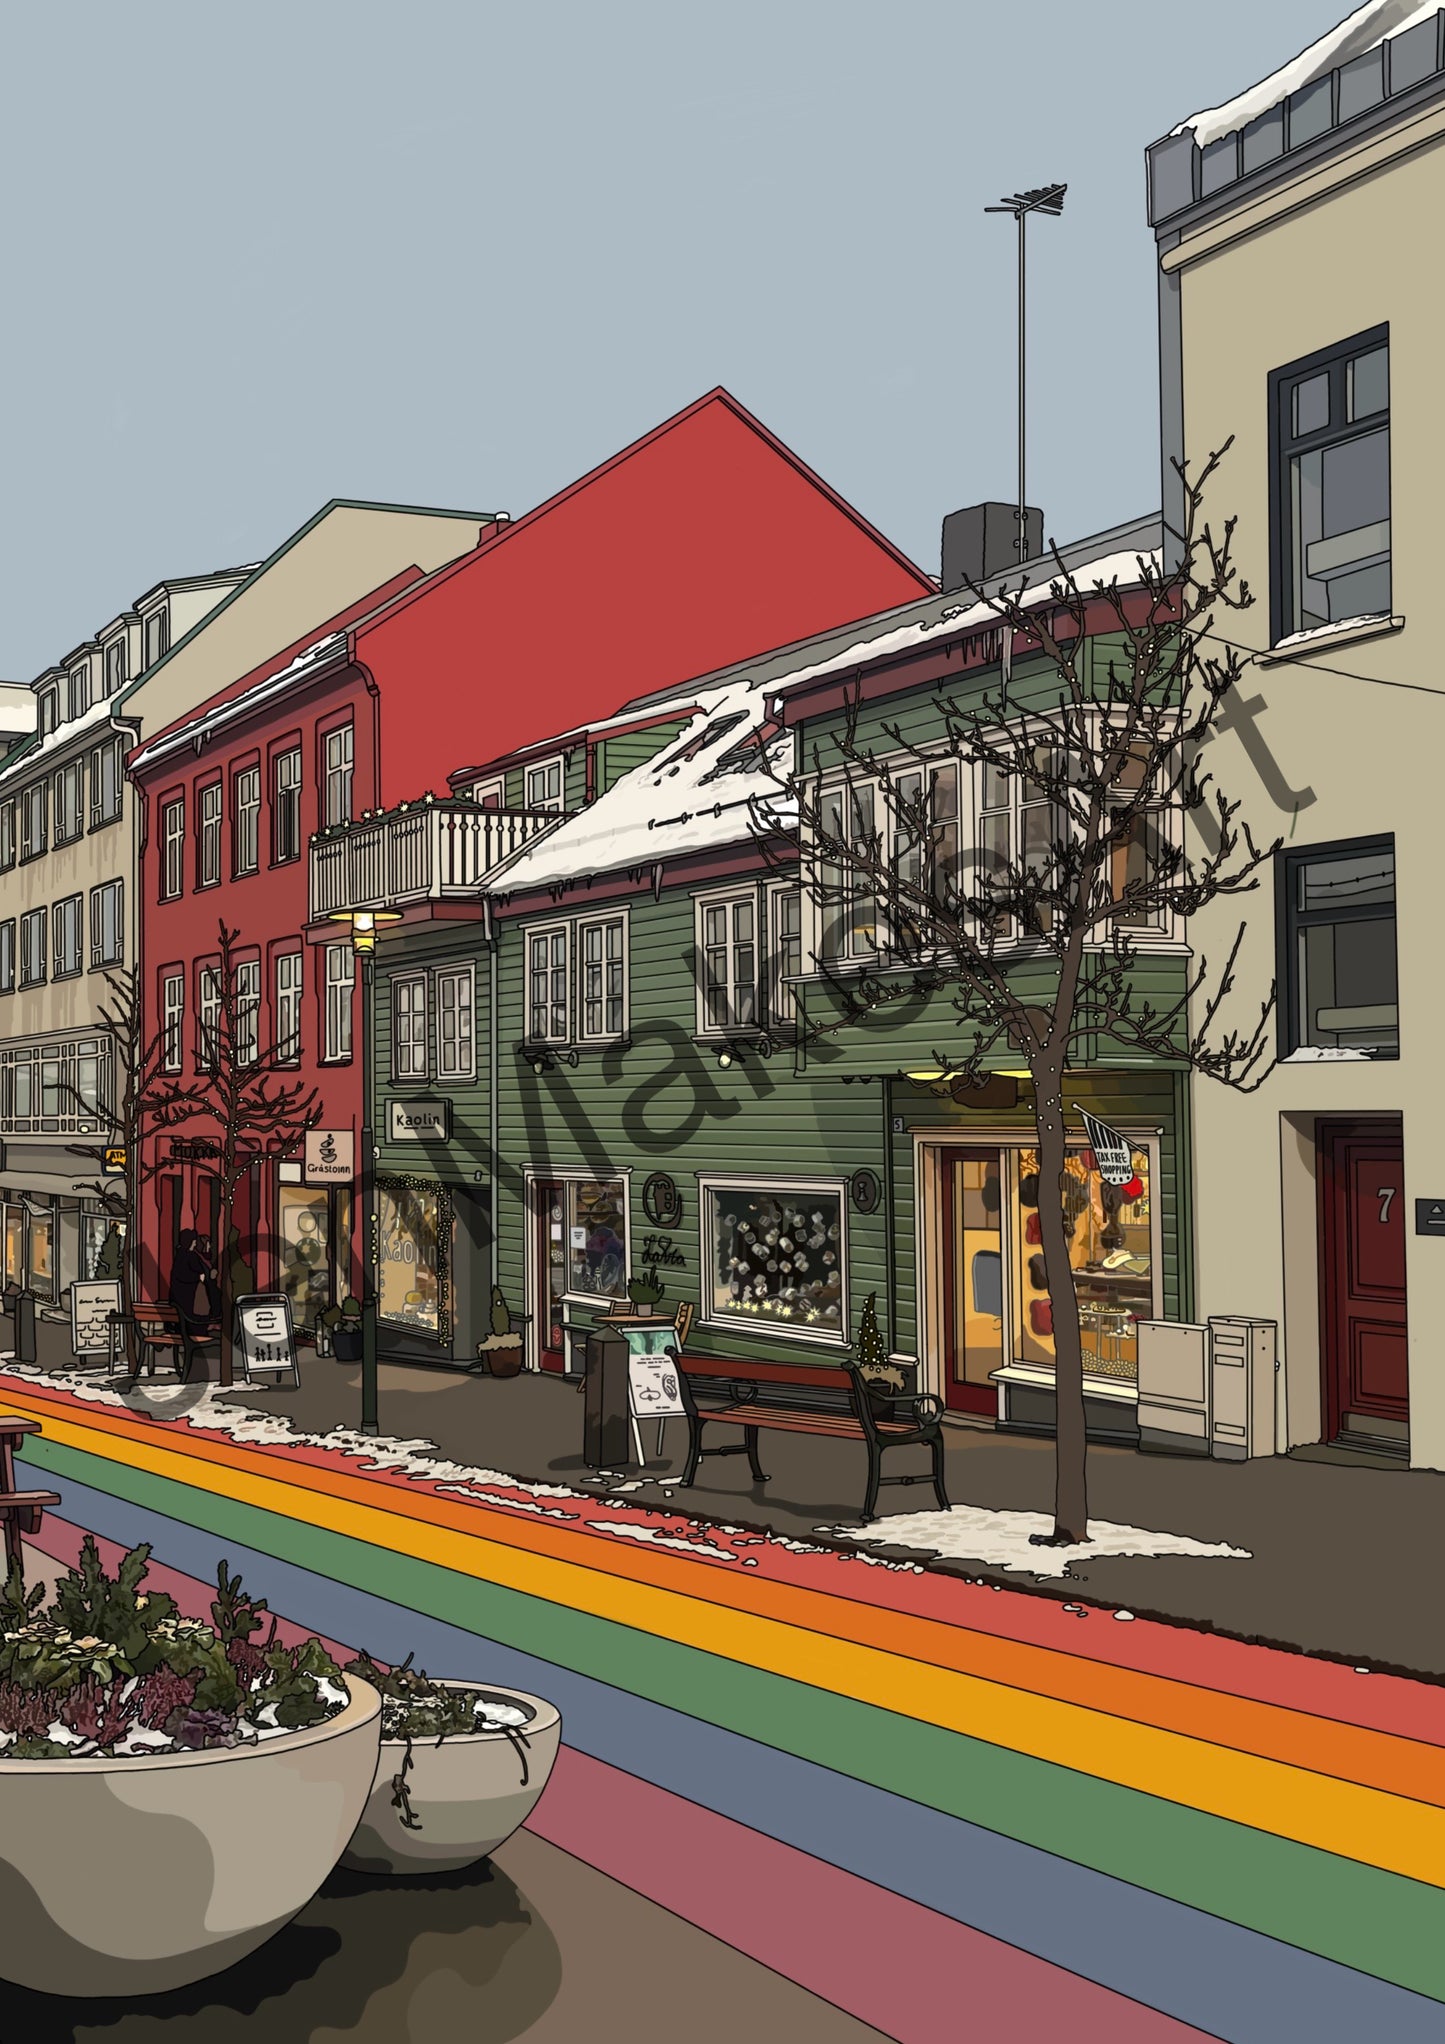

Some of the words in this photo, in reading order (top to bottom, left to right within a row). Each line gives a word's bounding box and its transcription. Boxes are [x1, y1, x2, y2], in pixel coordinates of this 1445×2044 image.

[396, 1113, 440, 1127] Kaolin
[110, 1151, 127, 1160] ATM
[1097, 1152, 1111, 1163] TAX
[1111, 1152, 1127, 1163] FREE
[1101, 1164, 1132, 1175] SHOPPING
[1377, 1187, 1397, 1223] 7
